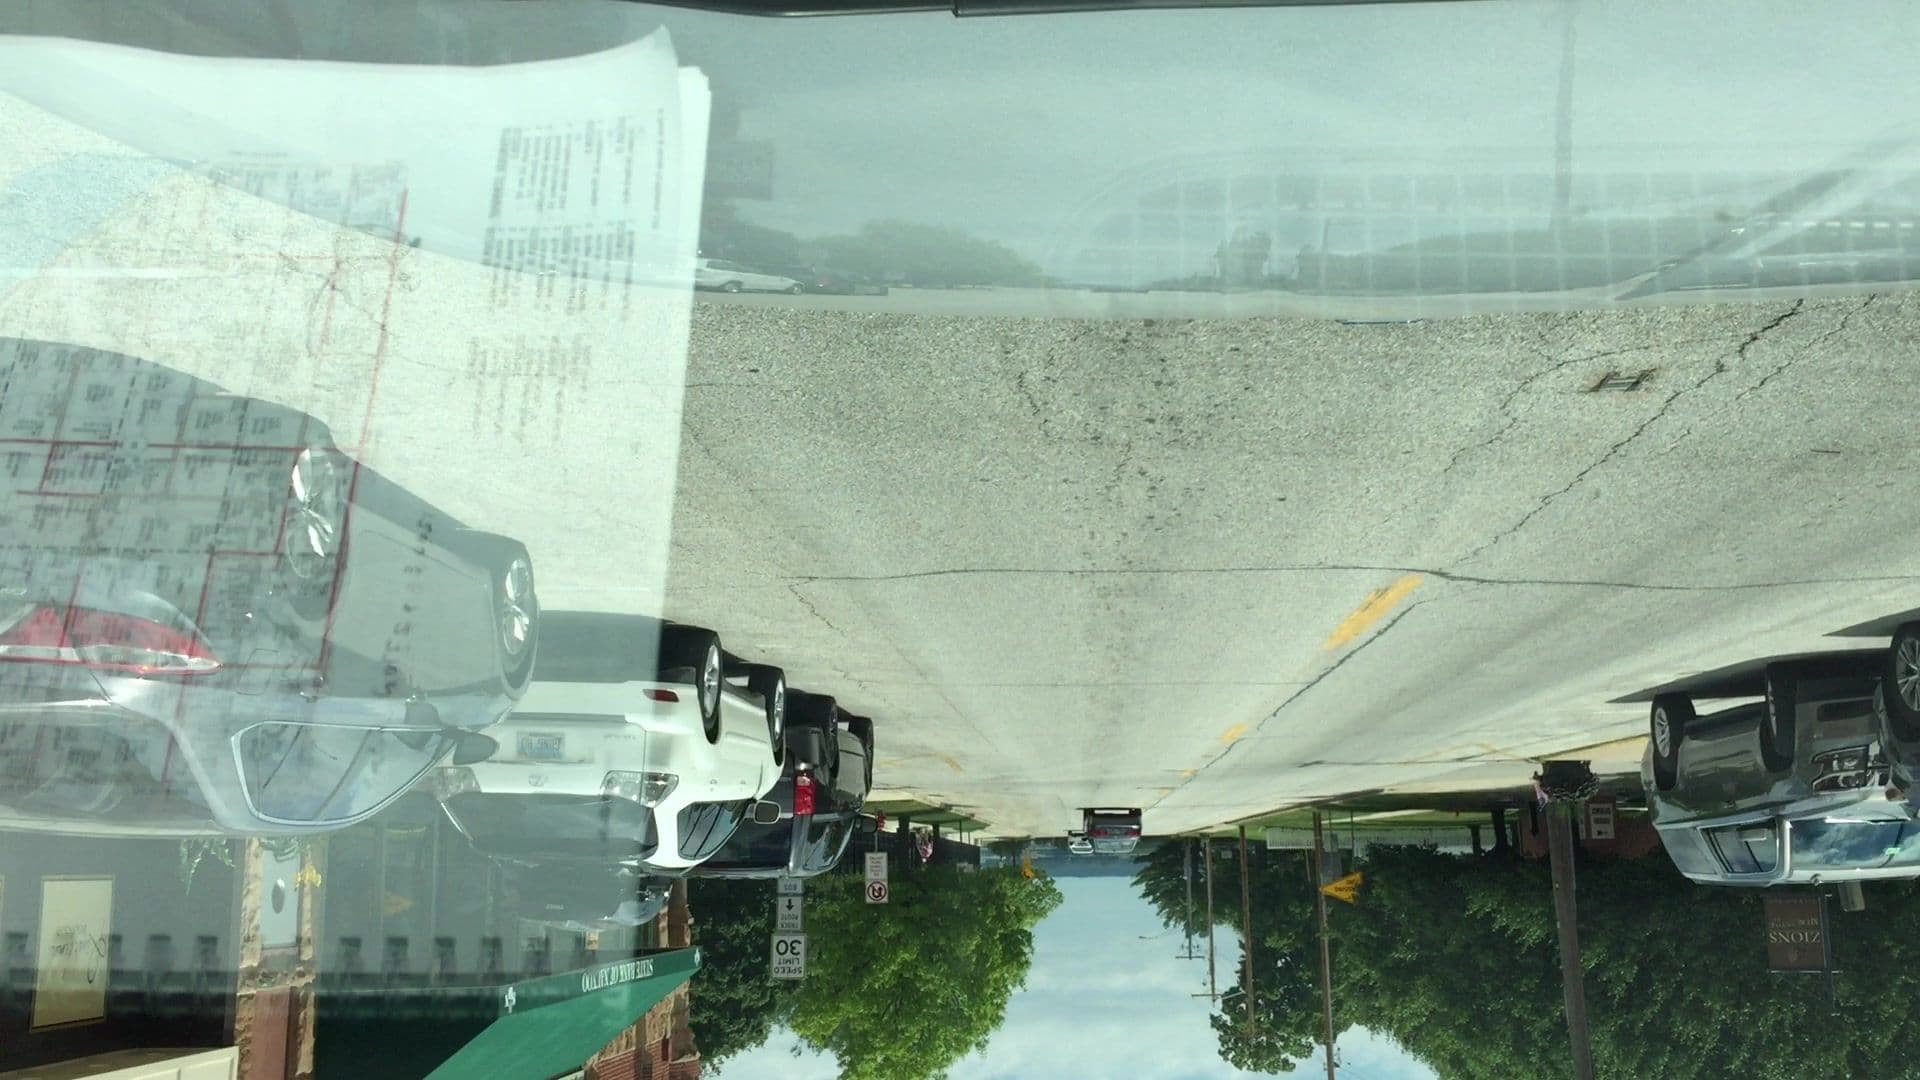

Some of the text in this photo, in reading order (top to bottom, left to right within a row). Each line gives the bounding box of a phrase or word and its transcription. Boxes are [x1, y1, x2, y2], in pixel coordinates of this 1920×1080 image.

[1769, 930, 1820, 944] ZIONS
[776, 940, 802, 956] 30
[635, 958, 654, 980] STATE
[777, 957, 800, 965] LIMIT
[609, 966, 619, 985] OF
[618, 962, 636, 983] BANK
[774, 966, 802, 974] SPEED
